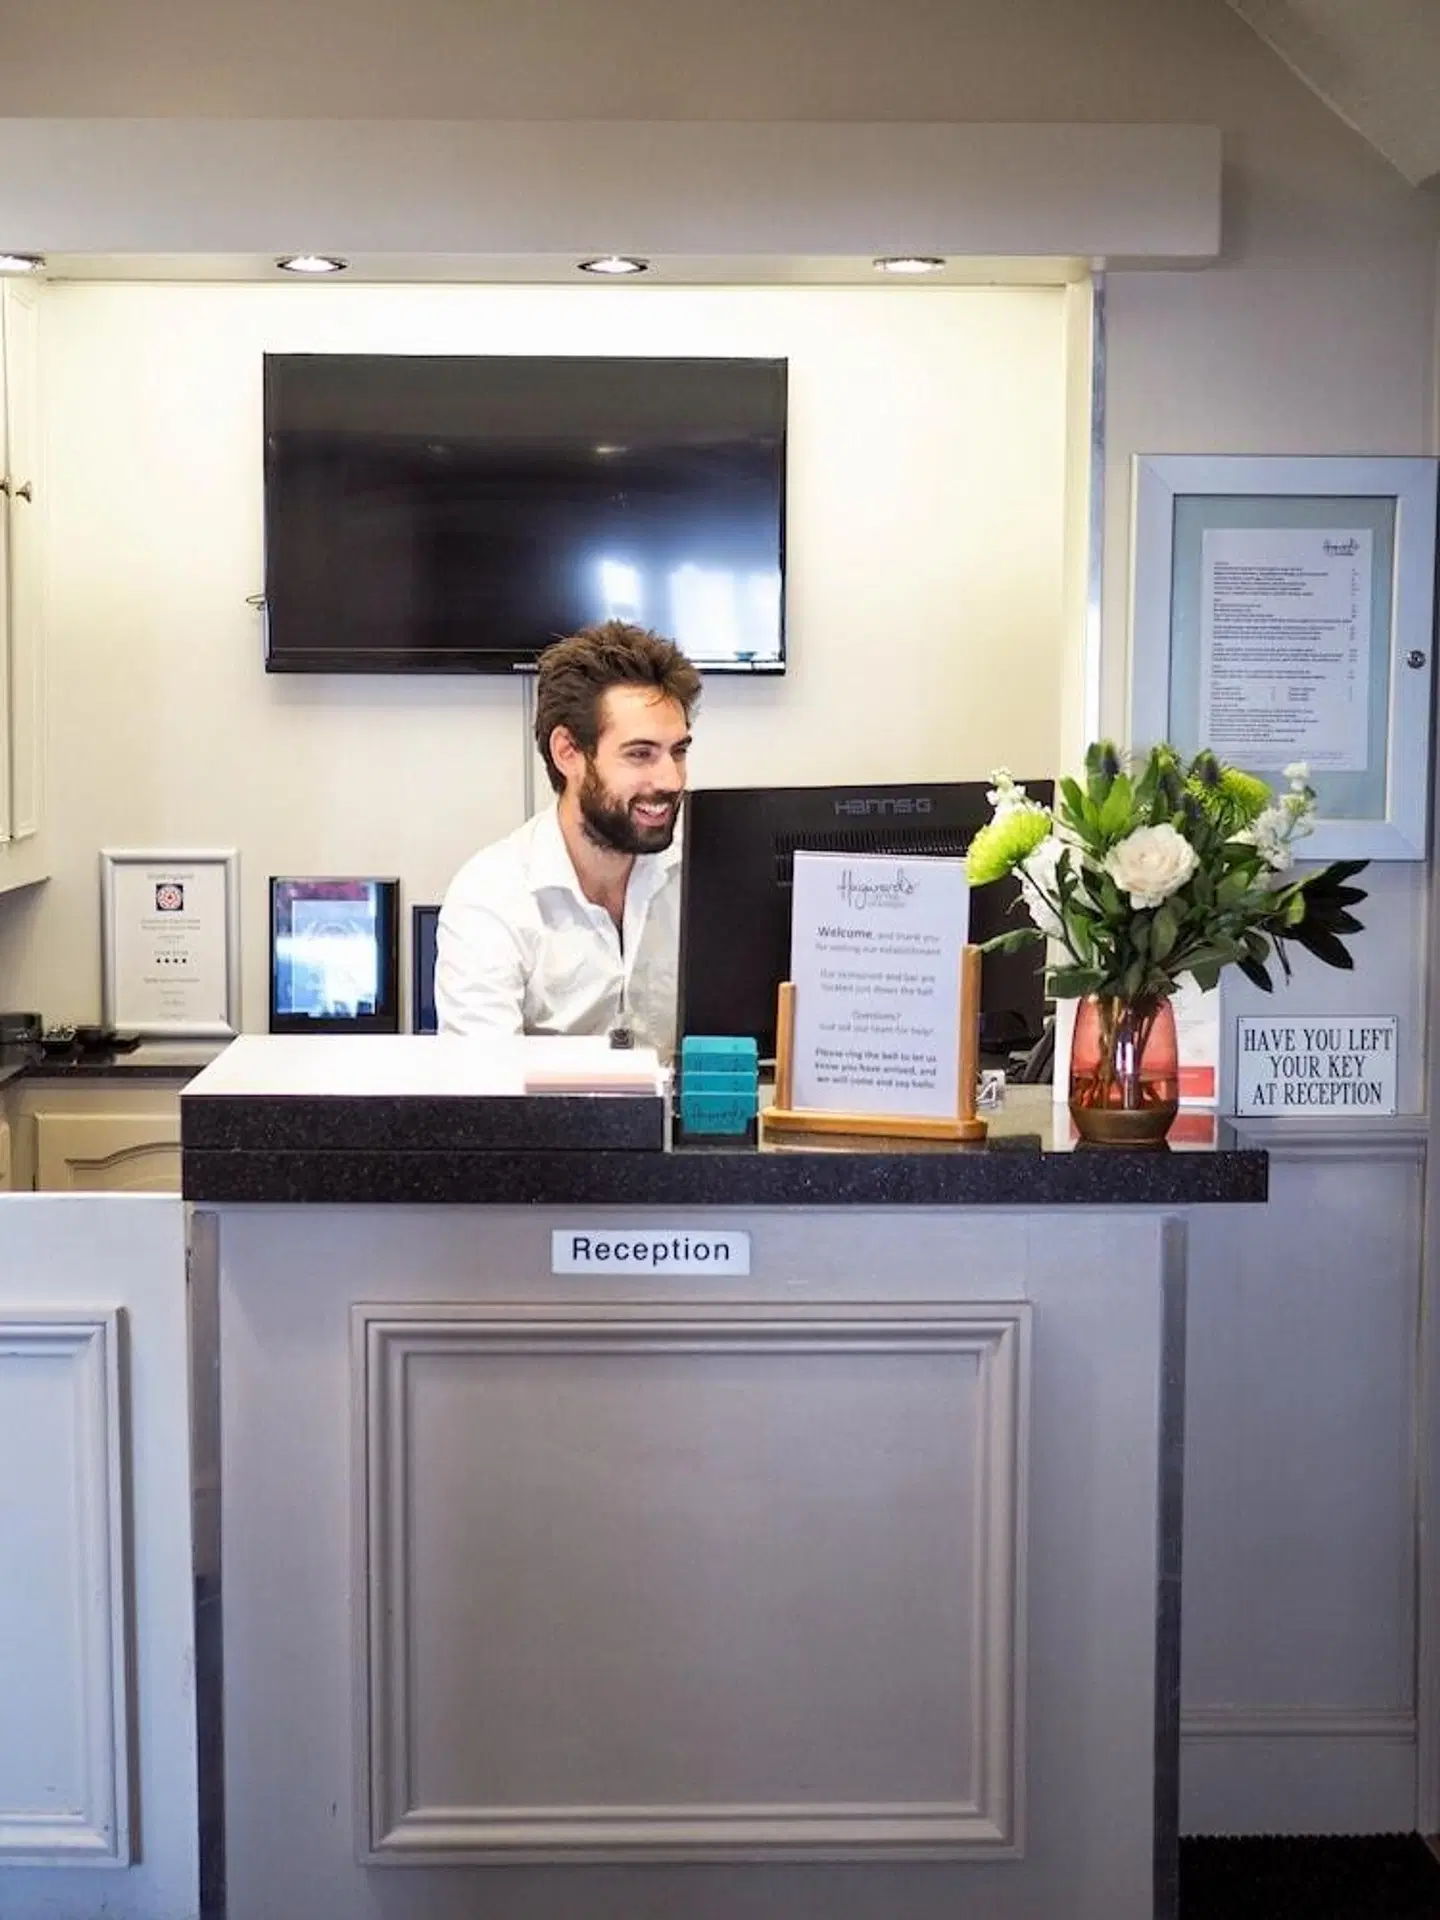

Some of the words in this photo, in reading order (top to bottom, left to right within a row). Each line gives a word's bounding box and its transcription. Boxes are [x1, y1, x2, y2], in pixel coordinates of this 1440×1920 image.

[1244, 1029, 1296, 1051] HAVE
[1304, 1028, 1341, 1051] YOU
[1349, 1028, 1393, 1051] LEFT
[1269, 1056, 1321, 1078] YOUR
[1328, 1055, 1367, 1078] KEY
[1252, 1083, 1279, 1105] AT
[1284, 1082, 1382, 1105] RECEPTION
[572, 1237, 730, 1267] Reception
